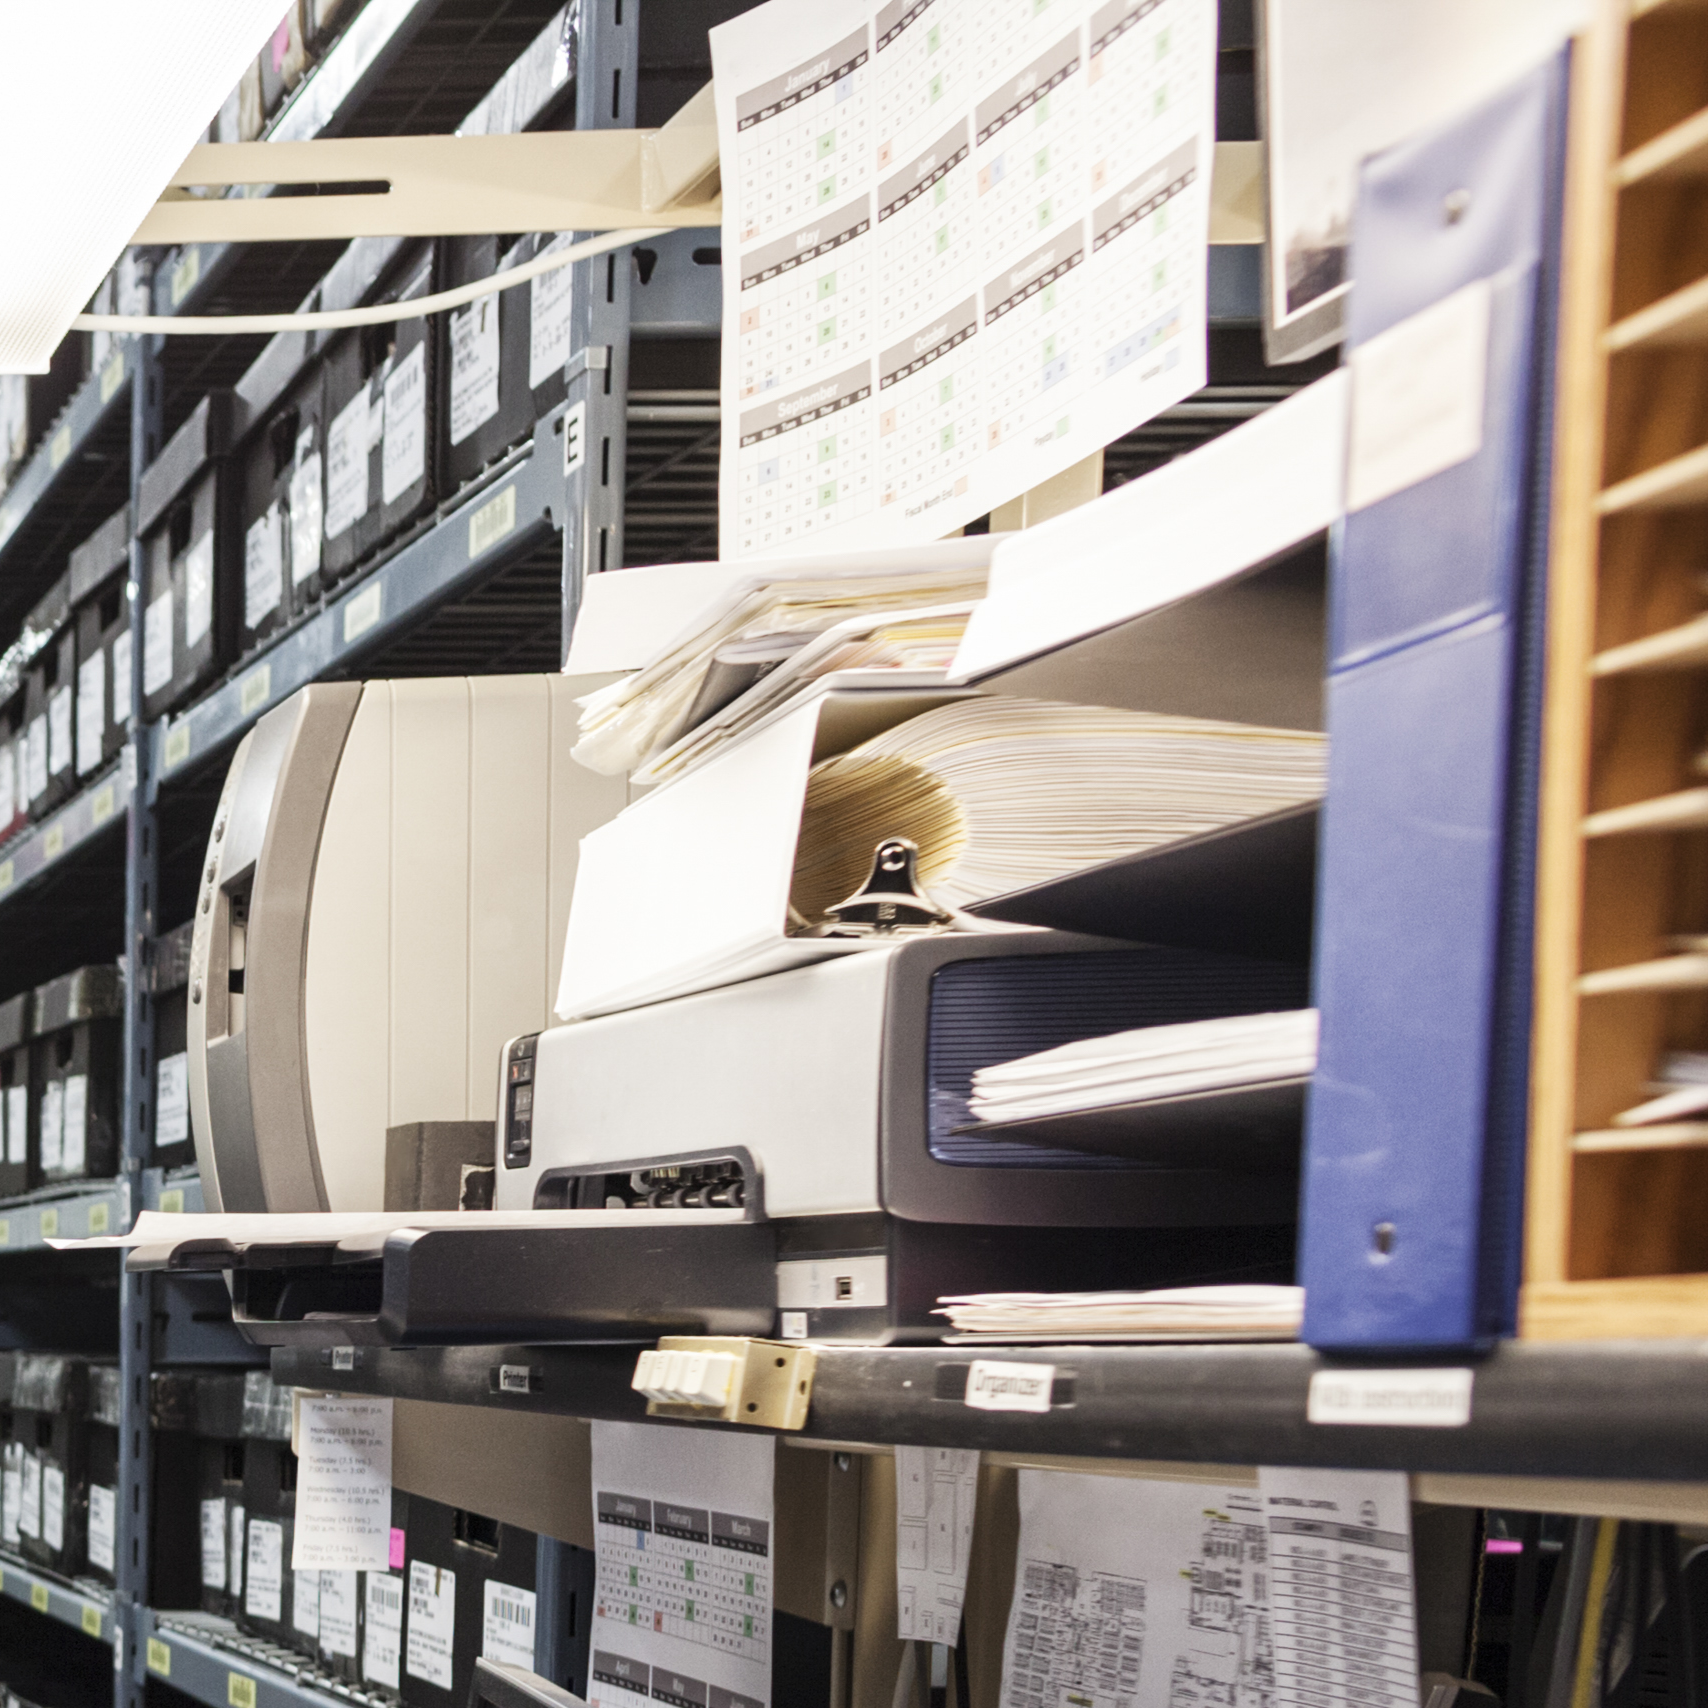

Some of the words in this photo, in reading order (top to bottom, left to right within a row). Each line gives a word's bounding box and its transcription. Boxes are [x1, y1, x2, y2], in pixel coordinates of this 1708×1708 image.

[784, 58, 830, 92] January
[796, 229, 820, 250] May
[914, 323, 949, 353] October
[778, 383, 839, 418] September
[568, 417, 578, 463] E
[743, 435, 756, 445] Sun
[762, 427, 777, 439] Mon
[905, 502, 922, 519] Fiscal
[924, 492, 941, 509] Month
[503, 1370, 527, 1388] Printer
[975, 1369, 1044, 1398] Organizer
[310, 1427, 336, 1435] Monday
[309, 1456, 337, 1464] Tuesday
[348, 1487, 366, 1495] (10.5
[615, 1499, 636, 1517] January
[305, 1515, 336, 1523] Thursday
[355, 1516, 371, 1524] hrs.)
[667, 1508, 692, 1528] February
[731, 1520, 751, 1537] March
[303, 1544, 323, 1552] Friday
[325, 1544, 339, 1552] (7.5
[342, 1545, 358, 1553] hrs.)
[615, 1661, 630, 1675] April
[672, 1678, 684, 1696] May
